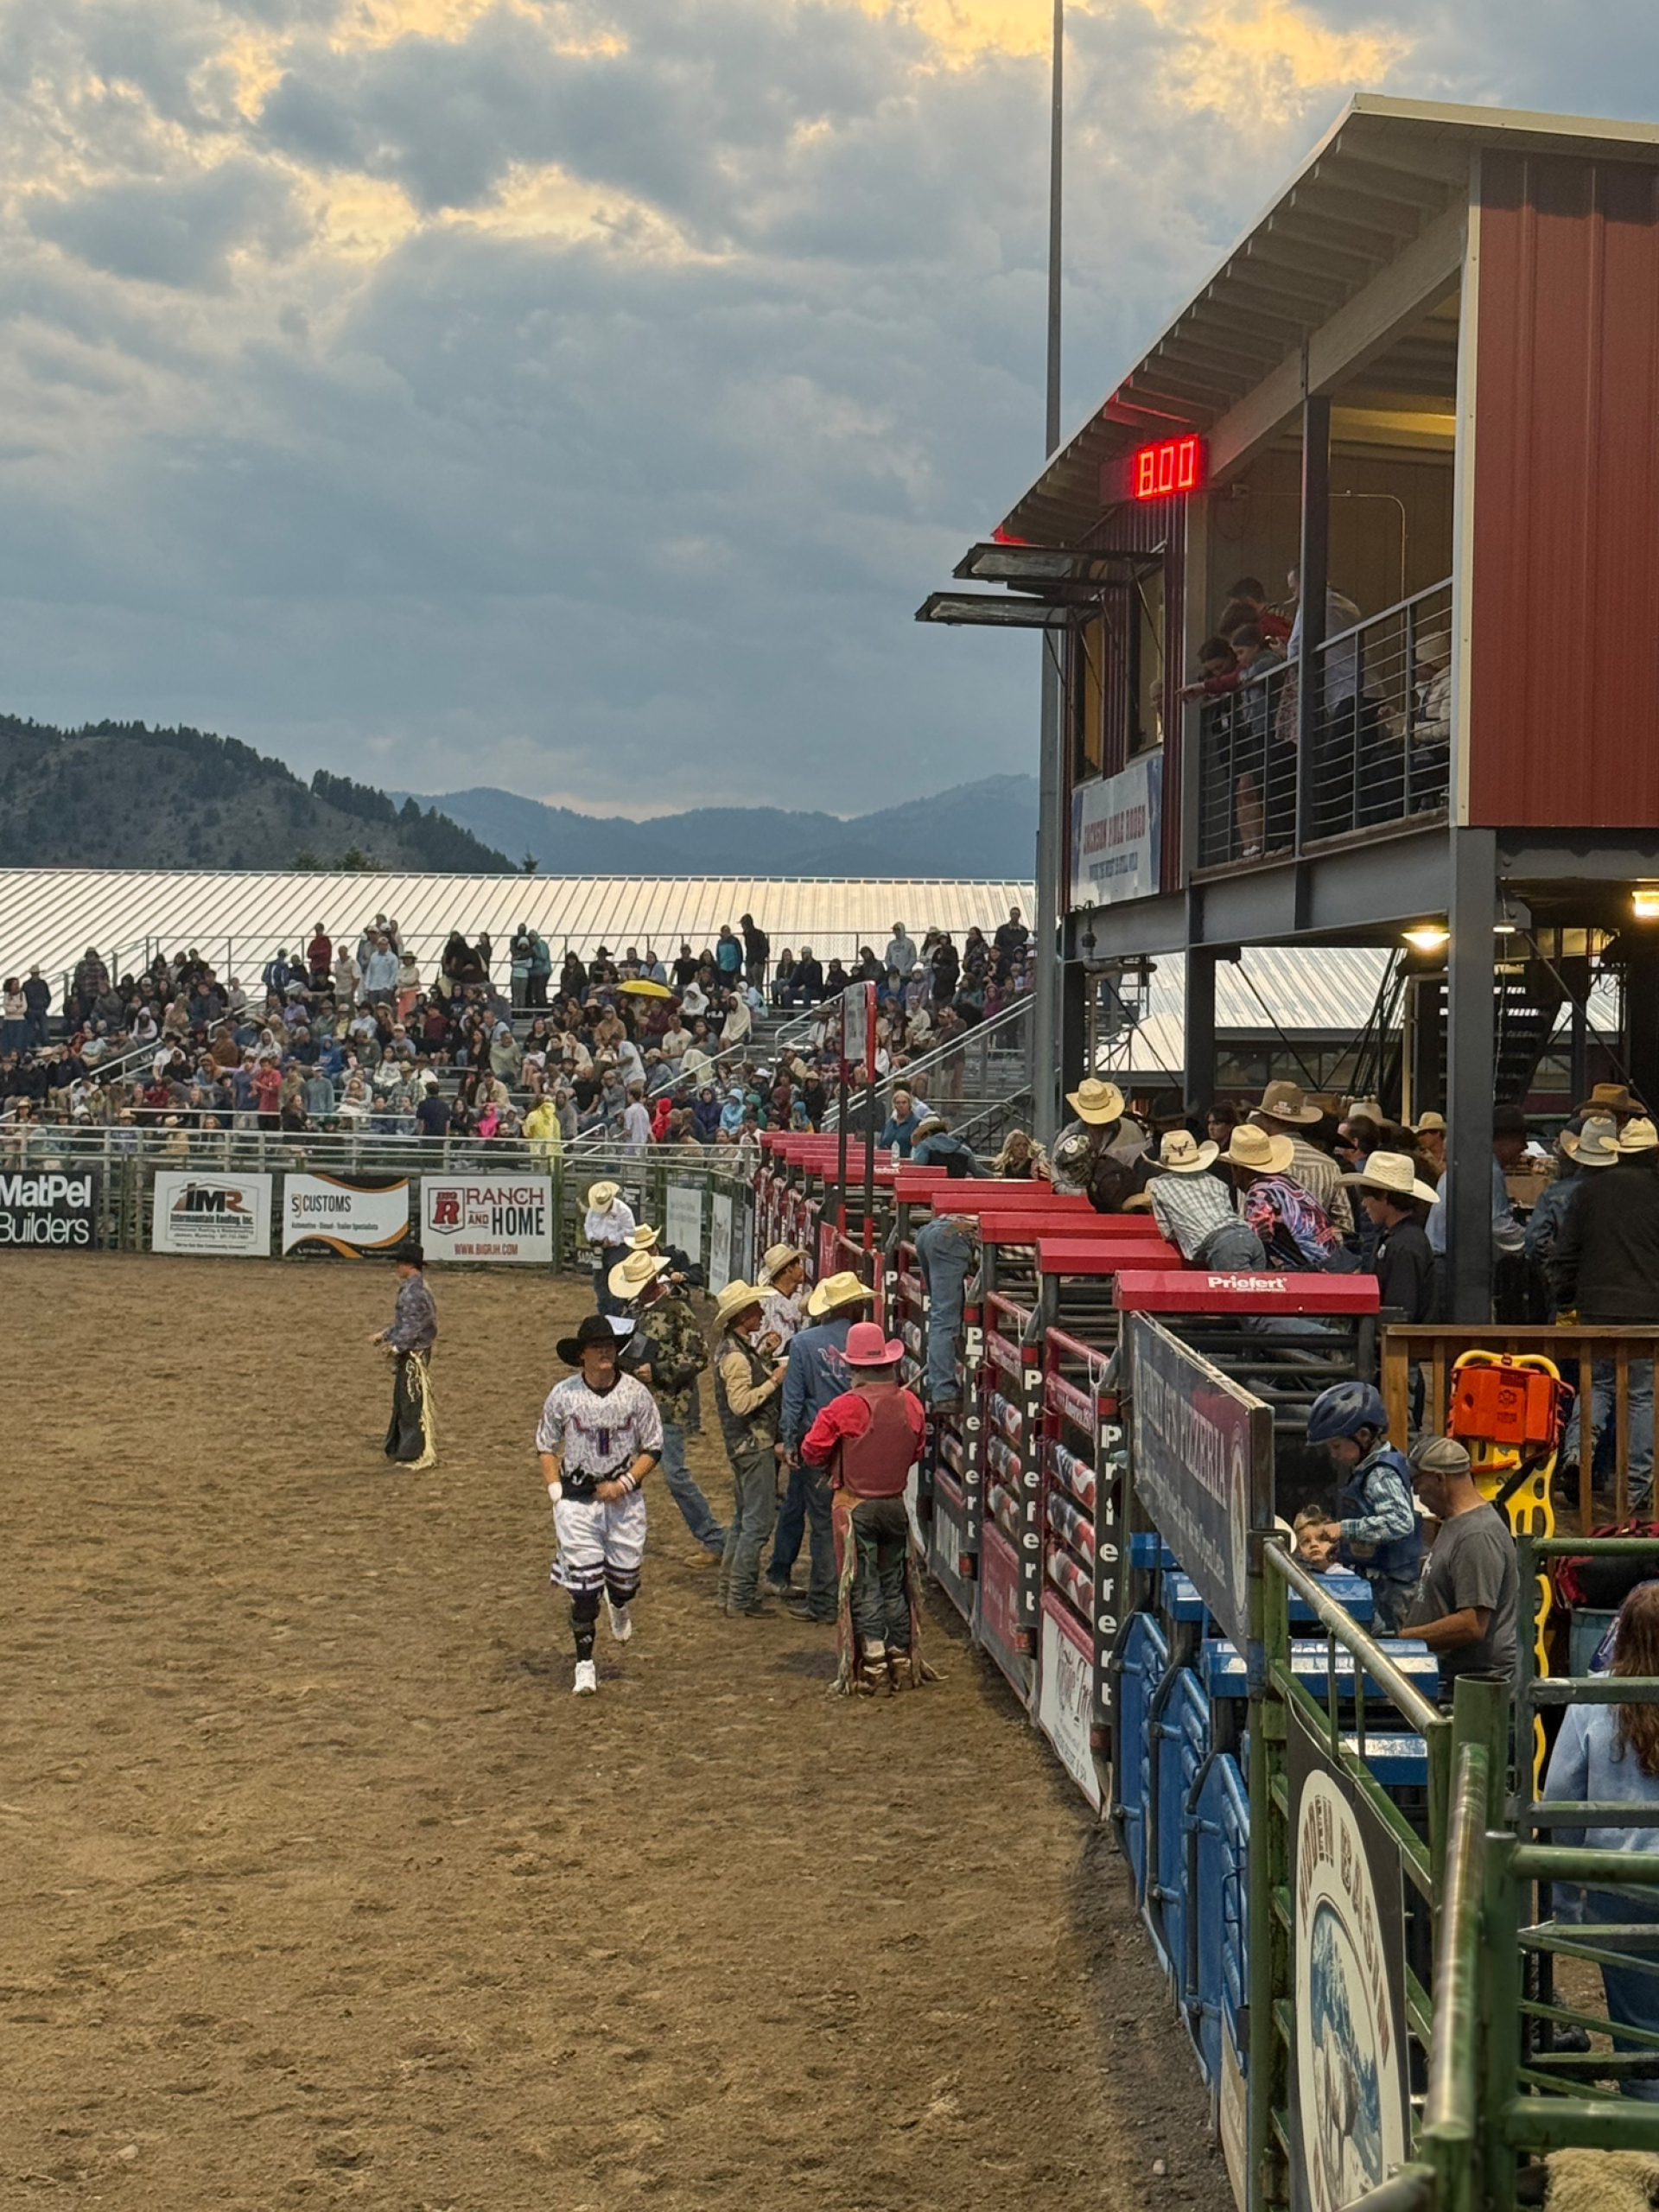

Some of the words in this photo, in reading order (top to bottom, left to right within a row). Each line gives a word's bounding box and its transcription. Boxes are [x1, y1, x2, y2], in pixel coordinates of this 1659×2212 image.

[0, 1174, 92, 1207] MatPel
[185, 1188, 253, 1214] IMR
[302, 1194, 352, 1212] CUSTOMS
[466, 1187, 545, 1205] RANCH
[0, 1211, 90, 1244] Builders
[467, 1213, 490, 1224] AND
[492, 1206, 545, 1236] HOME
[1207, 1274, 1285, 1289] Priefert
[1022, 1370, 1043, 1612] Priefert
[1097, 1424, 1122, 1707] Priefert
